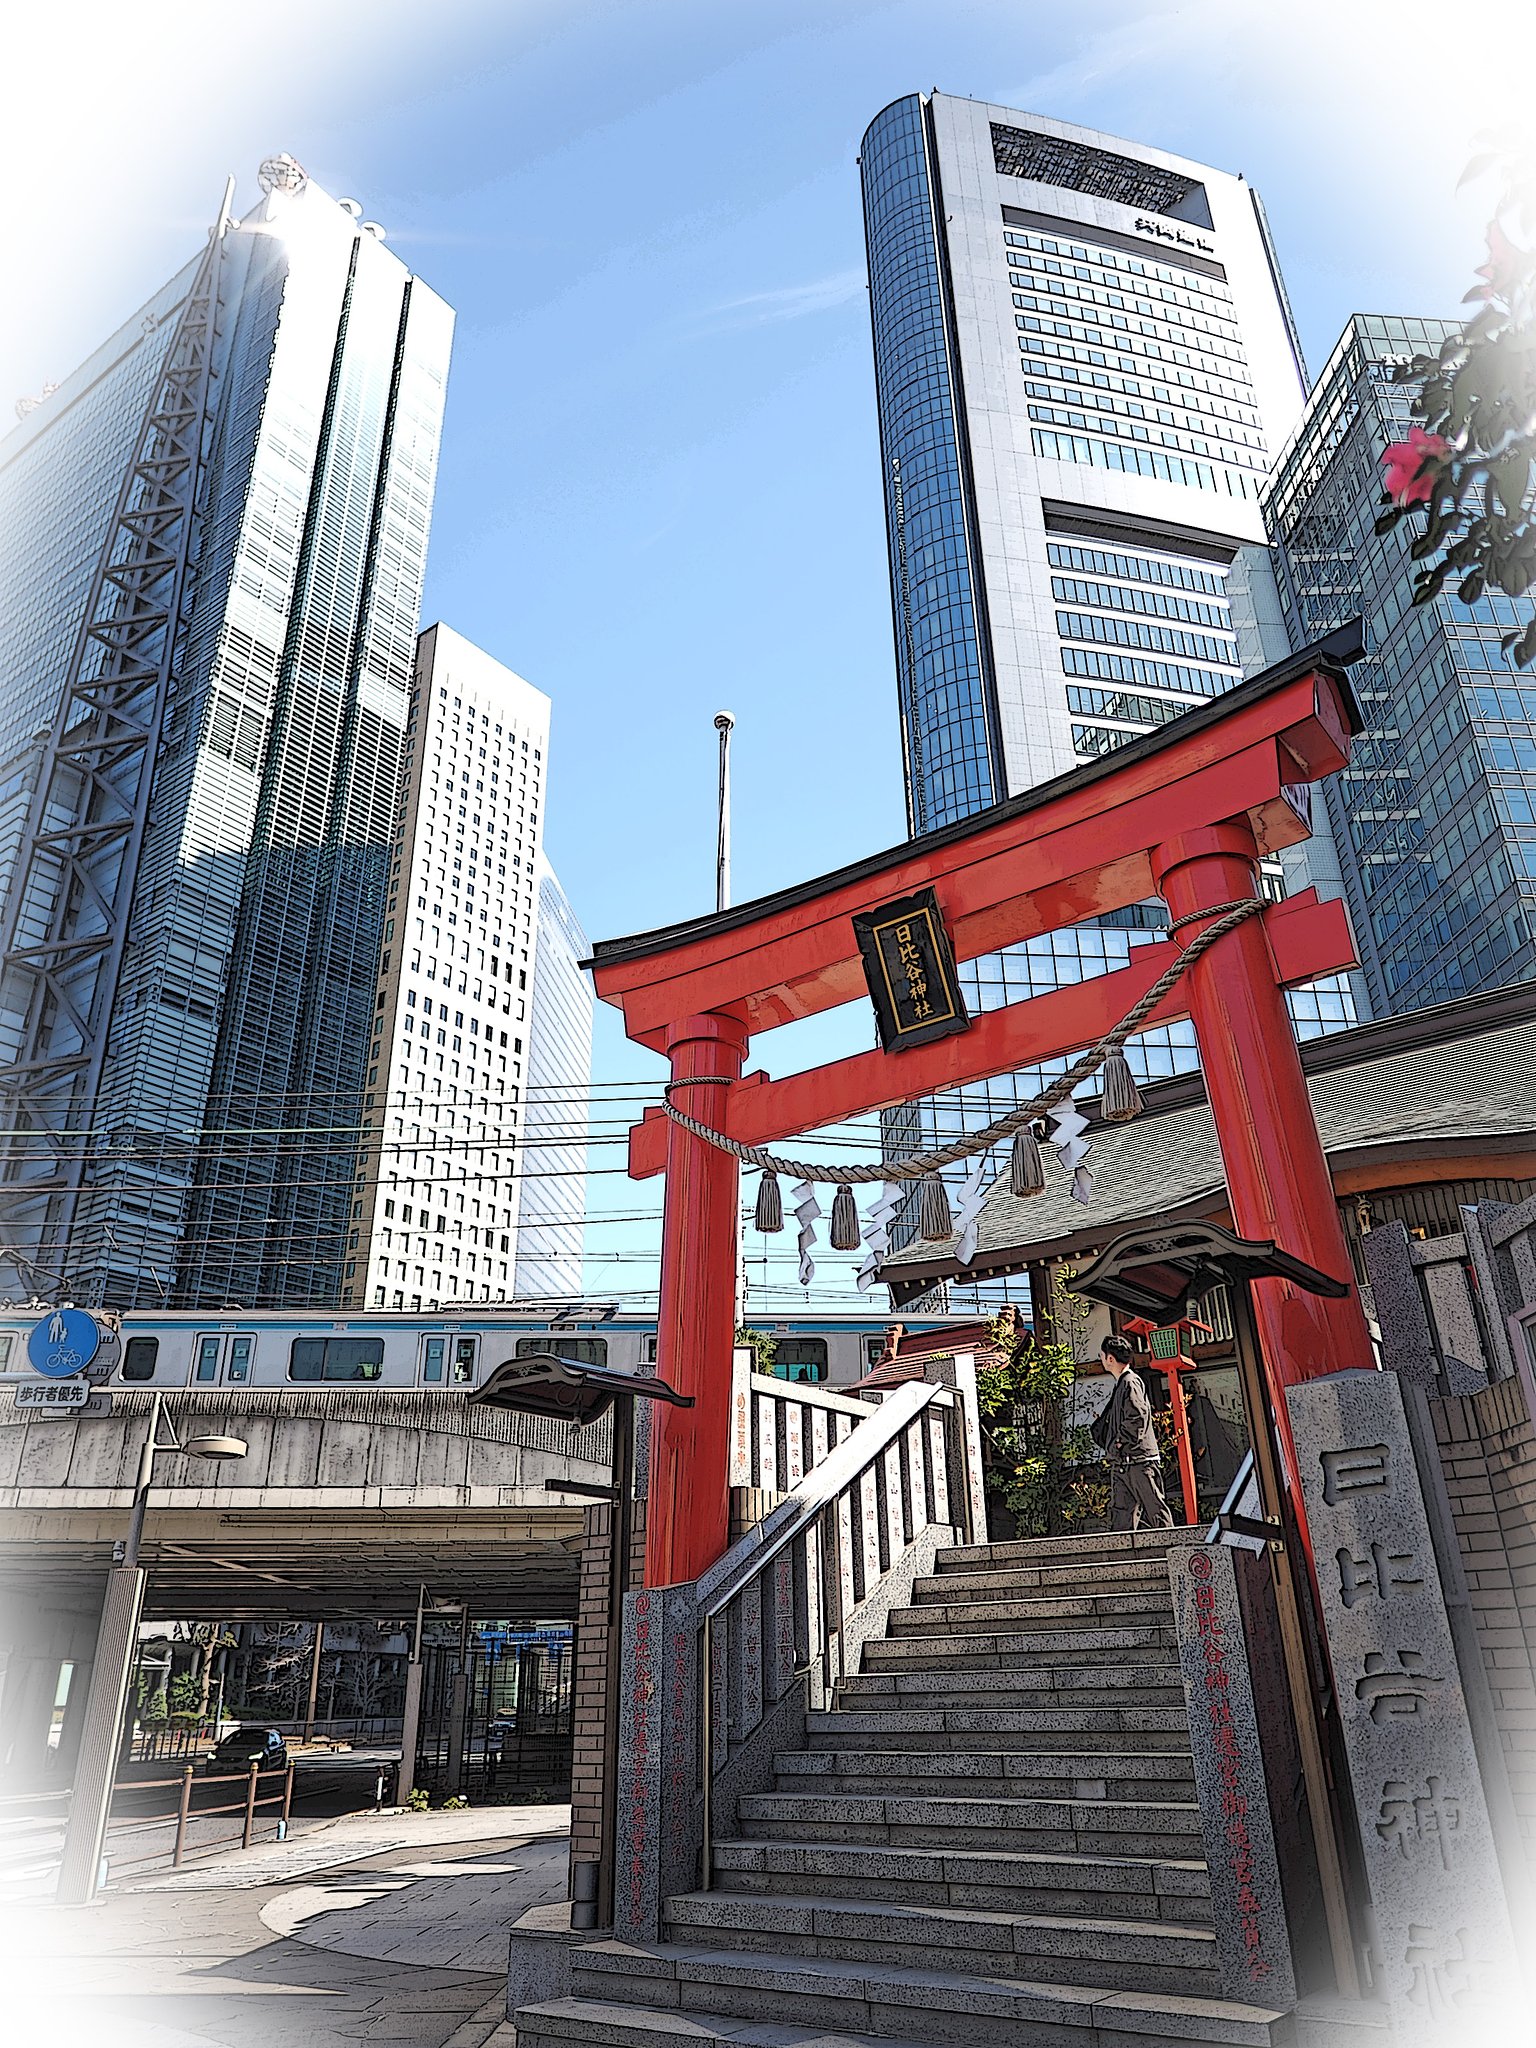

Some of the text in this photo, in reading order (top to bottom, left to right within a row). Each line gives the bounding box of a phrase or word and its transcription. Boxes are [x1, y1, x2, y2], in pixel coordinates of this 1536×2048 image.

[895, 923, 934, 1019] 日比谷神社
[20, 1384, 84, 1403] 歩行者優先
[1319, 1443, 1496, 2020] 日比谷神社
